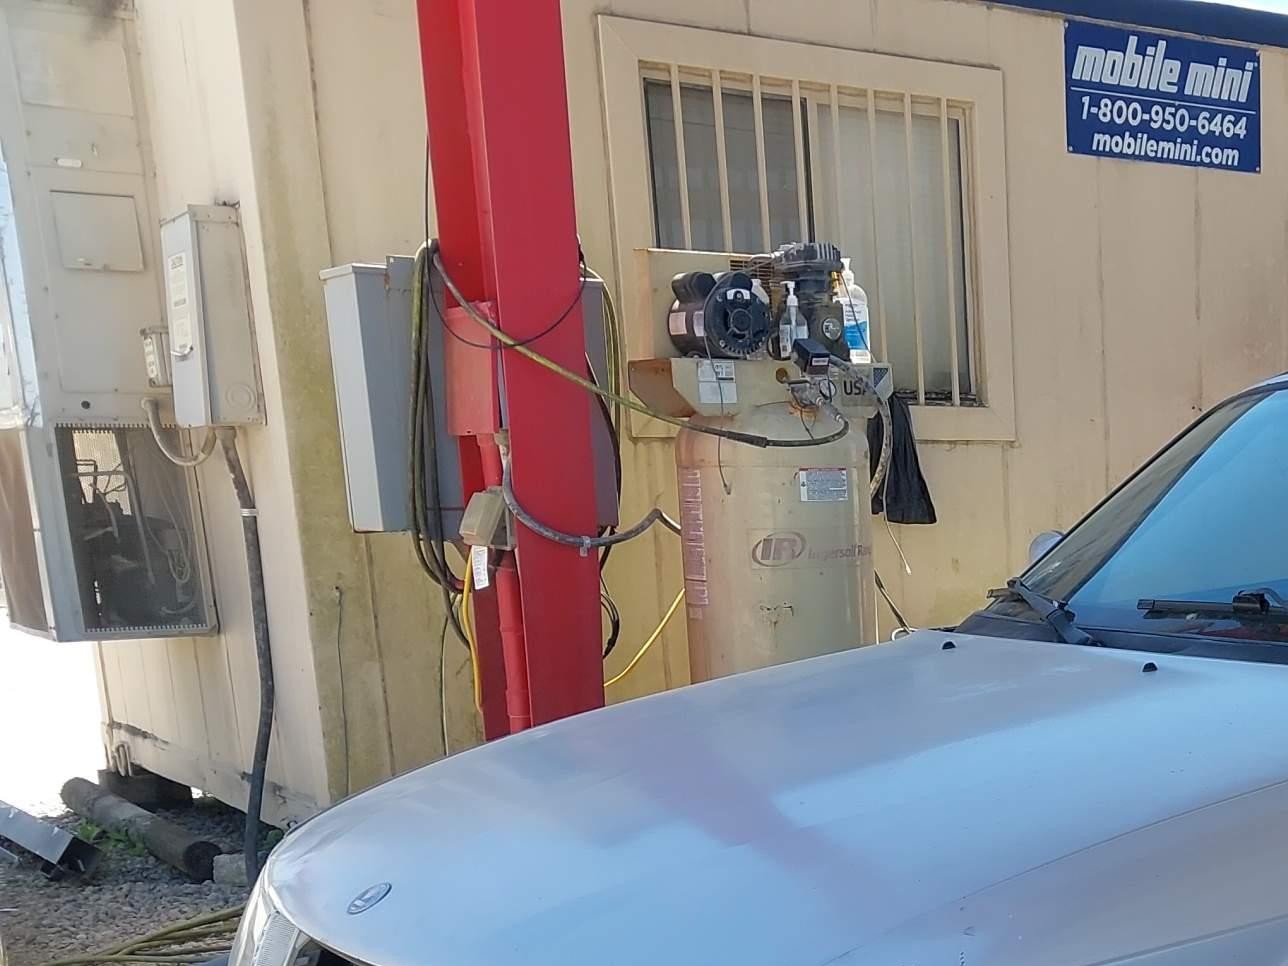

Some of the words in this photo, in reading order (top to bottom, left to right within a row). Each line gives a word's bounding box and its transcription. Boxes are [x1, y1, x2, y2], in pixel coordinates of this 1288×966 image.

[1072, 36, 1181, 93] mobile
[1184, 57, 1253, 102] mini
[1081, 96, 1247, 139] 1-800-950-6464
[1091, 131, 1239, 166] mobilemini.com
